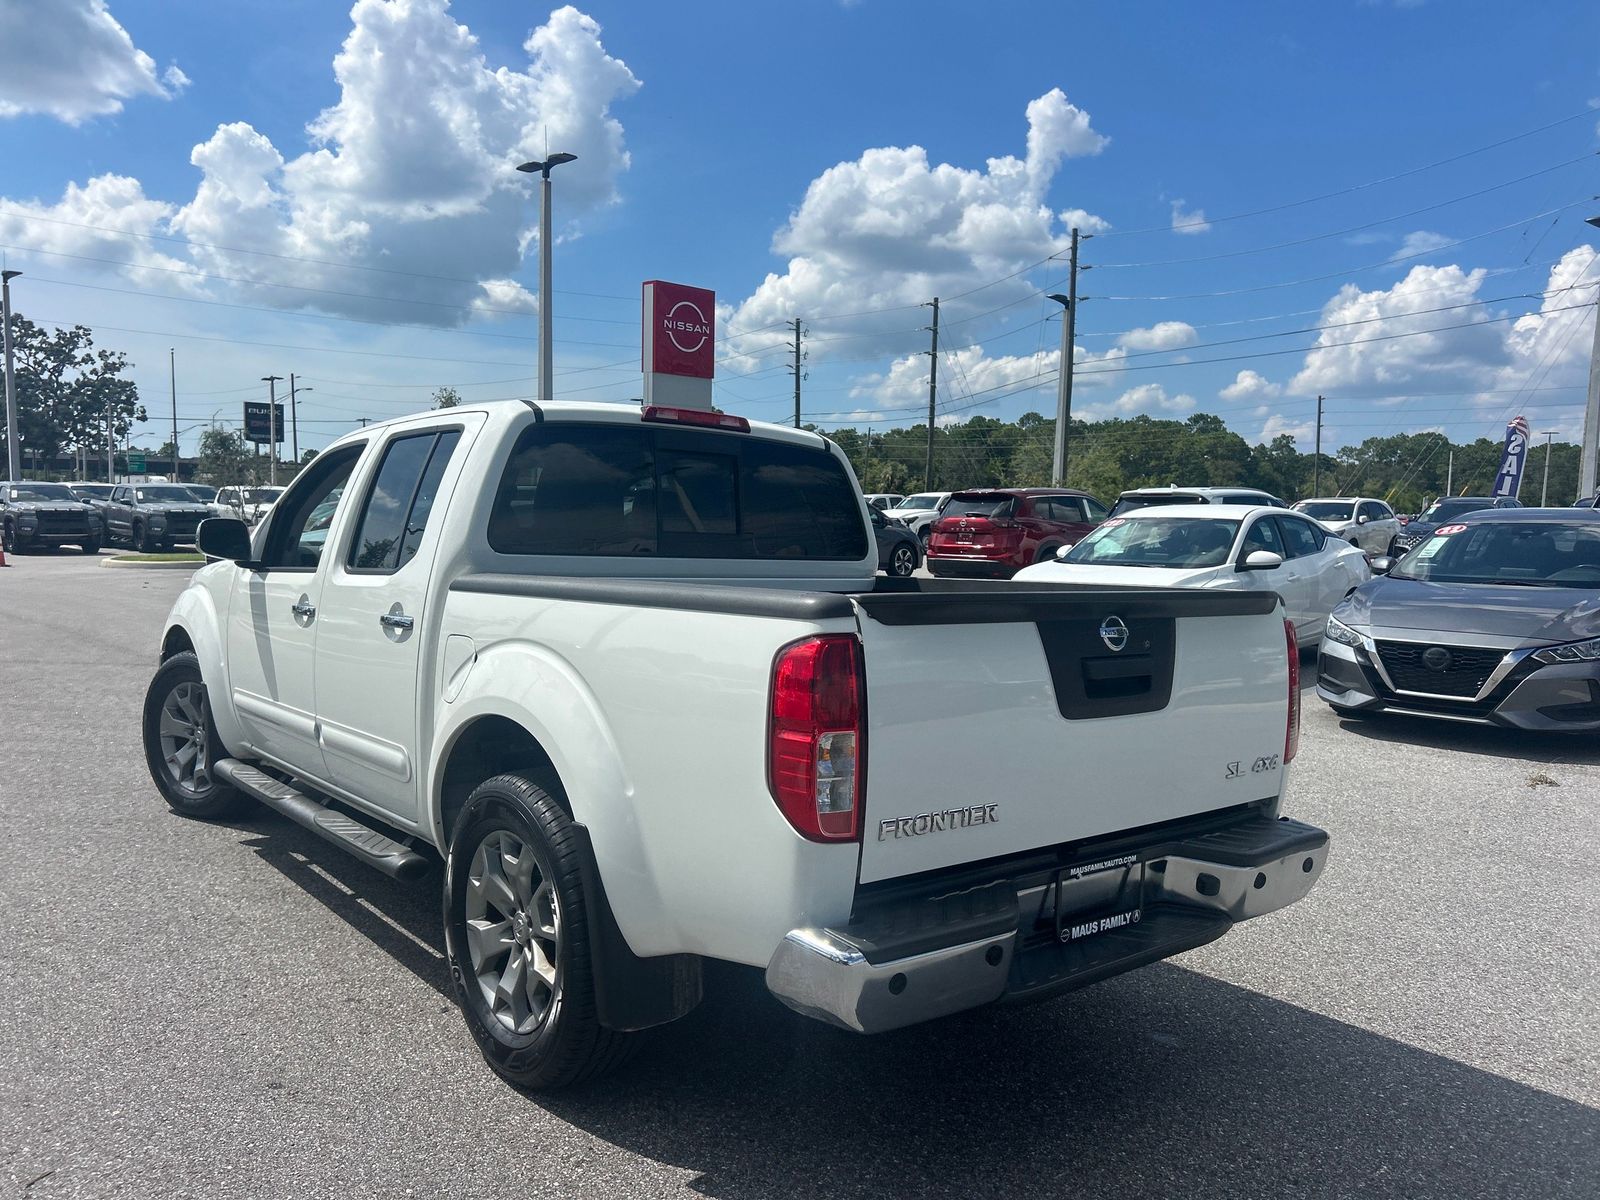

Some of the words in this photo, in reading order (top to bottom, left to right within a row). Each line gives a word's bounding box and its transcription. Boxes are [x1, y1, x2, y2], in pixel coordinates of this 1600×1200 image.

[663, 319, 710, 334] NISSAN
[1225, 761, 1246, 779] SL
[878, 802, 999, 841] FRONTIER
[1070, 855, 1137, 875] MAUSFAMILYAUTO.COM
[1071, 921, 1098, 939] MAUS
[1100, 912, 1132, 931] FAMILY
